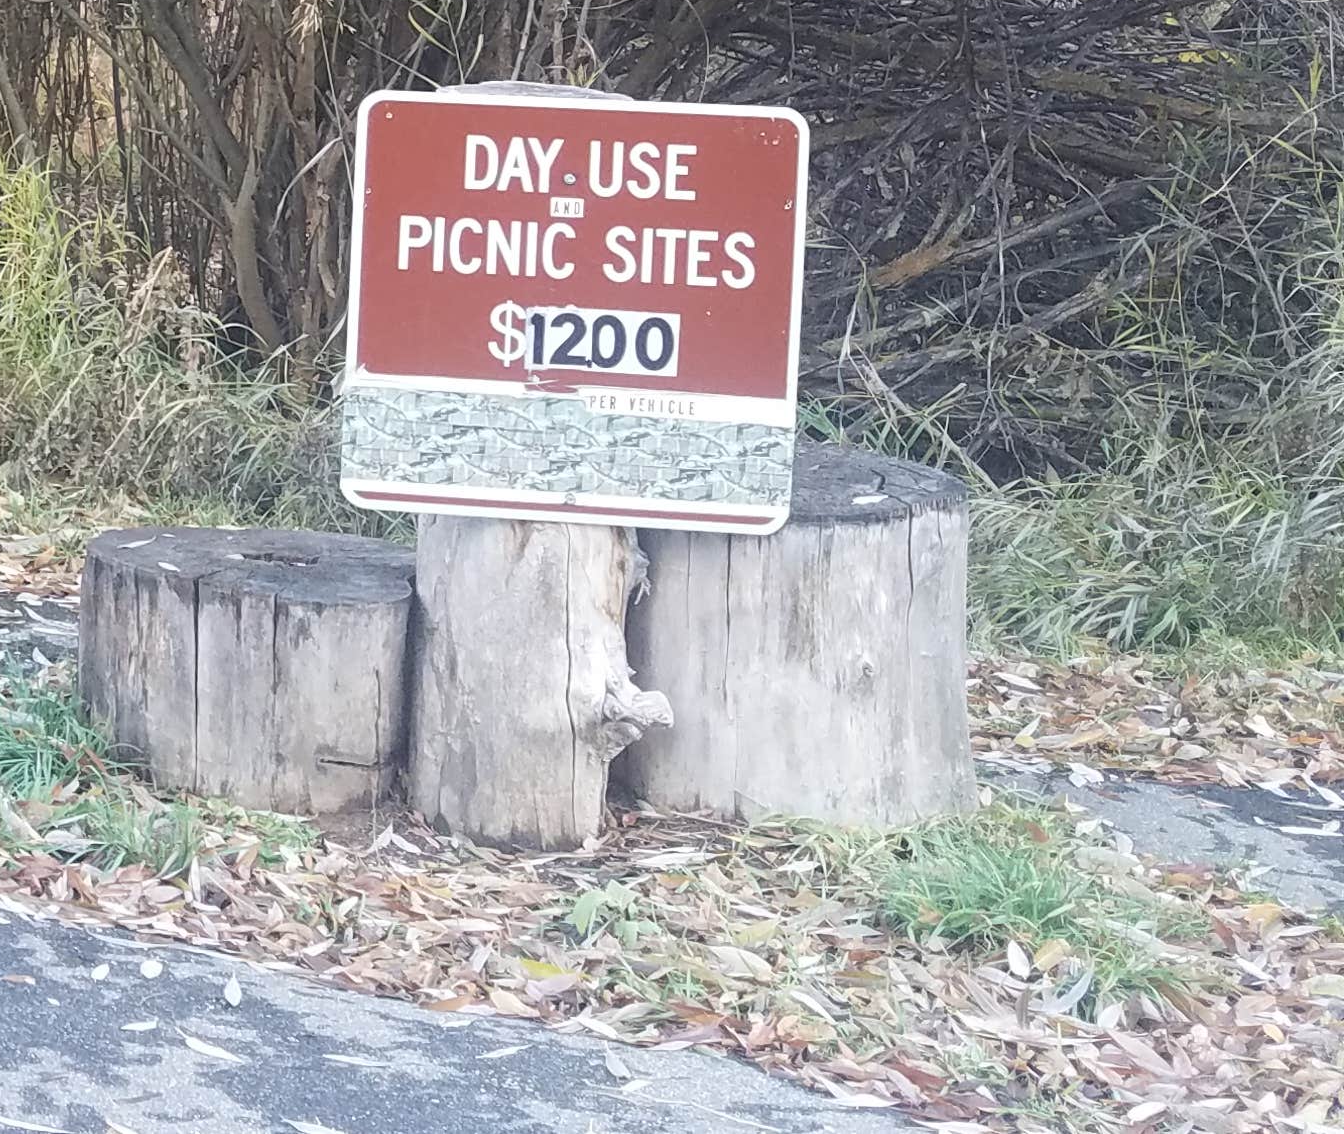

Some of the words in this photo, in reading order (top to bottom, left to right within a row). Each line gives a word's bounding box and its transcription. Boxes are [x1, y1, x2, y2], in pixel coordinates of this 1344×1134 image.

[464, 134, 565, 193] DAY
[588, 141, 698, 200] USE
[553, 201, 581, 215] AND
[397, 215, 576, 279] PICNIC
[602, 226, 756, 289] SITES
[589, 395, 617, 410] PER
[629, 397, 696, 416] VEHICLE
